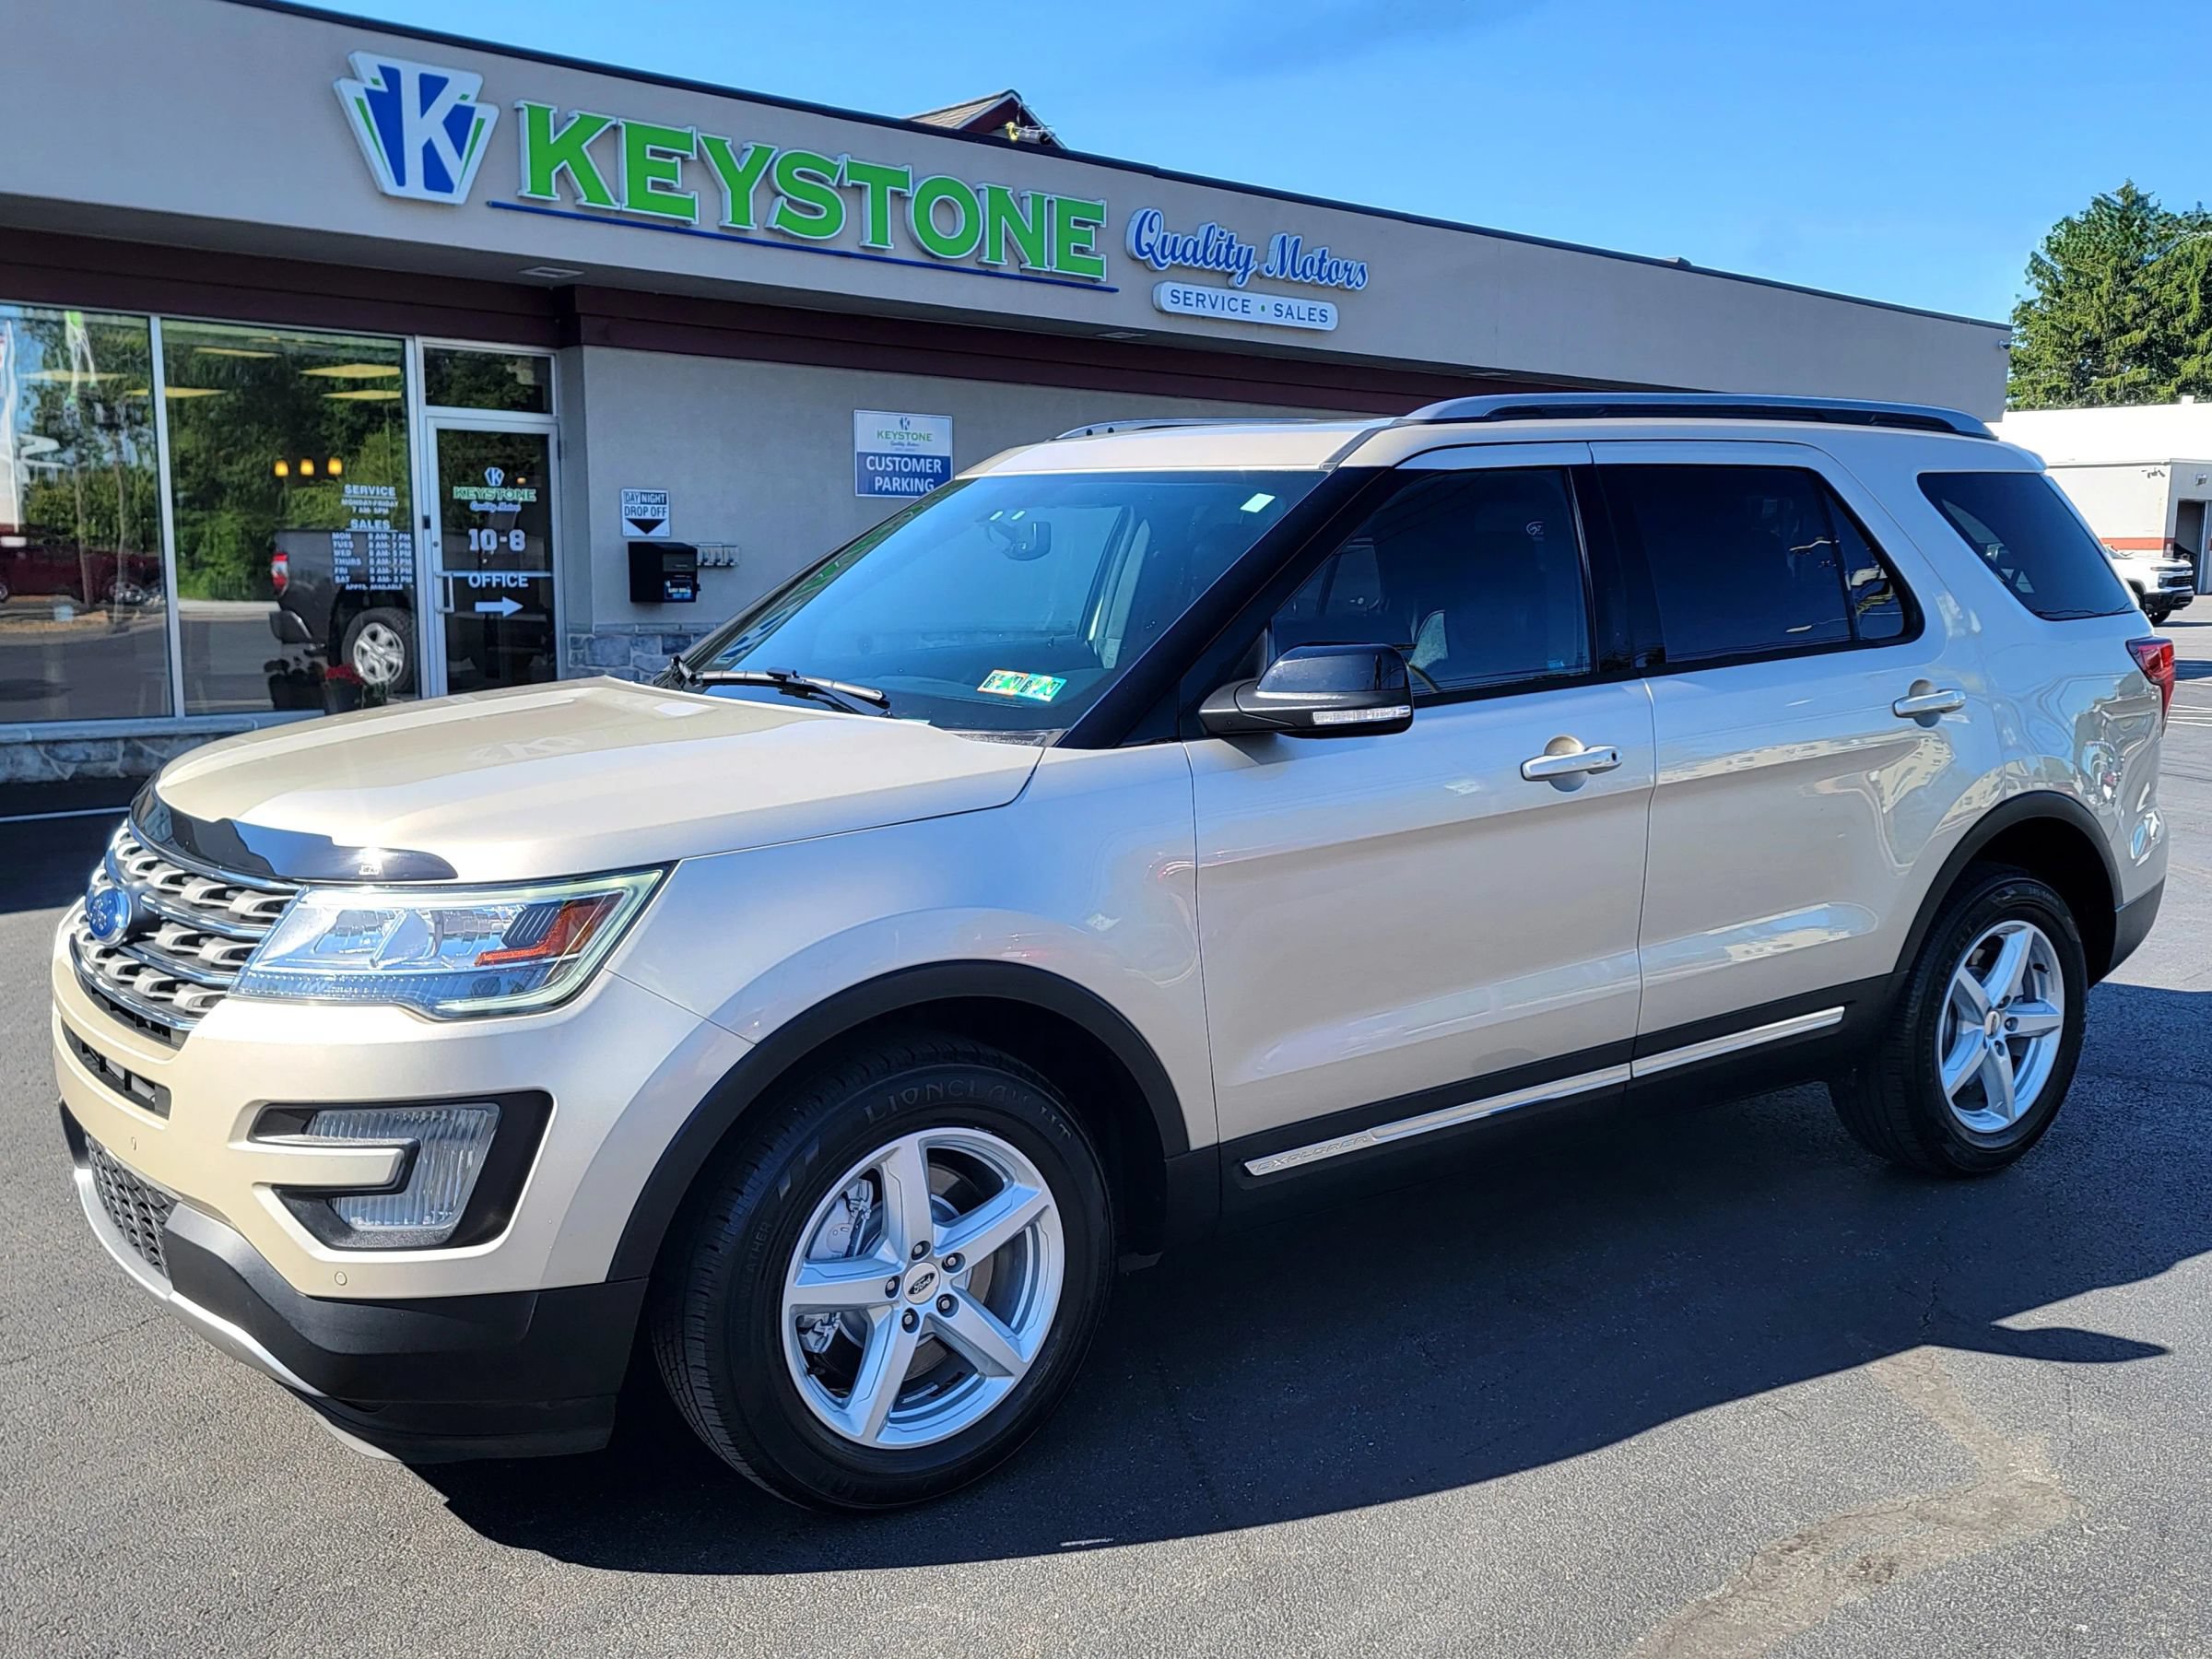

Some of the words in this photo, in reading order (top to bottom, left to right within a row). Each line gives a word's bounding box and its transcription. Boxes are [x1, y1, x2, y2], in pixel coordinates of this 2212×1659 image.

[514, 100, 1107, 282] KEYSTONE
[1134, 209, 1256, 287] Quality
[1265, 232, 1369, 289] Motors
[1170, 288, 1252, 315] SERVICE
[1273, 302, 1329, 324] SALES
[877, 430, 933, 441] KEYSTONE
[866, 455, 942, 474] CUSTOMER
[344, 484, 396, 496] SERVICE
[875, 476, 935, 492] PARKING
[453, 486, 536, 502] KEYSTONE
[624, 492, 641, 503] DAY
[641, 492, 666, 504] NIGHT
[624, 505, 650, 517] DROP
[650, 506, 667, 517] OFF
[350, 518, 391, 530] SALES
[333, 541, 355, 549] TUES
[468, 528, 525, 551] 10-8
[335, 558, 362, 566] THURS
[468, 573, 529, 588] OFFICE
[1256, 1135, 1367, 1171] EXPLORER
